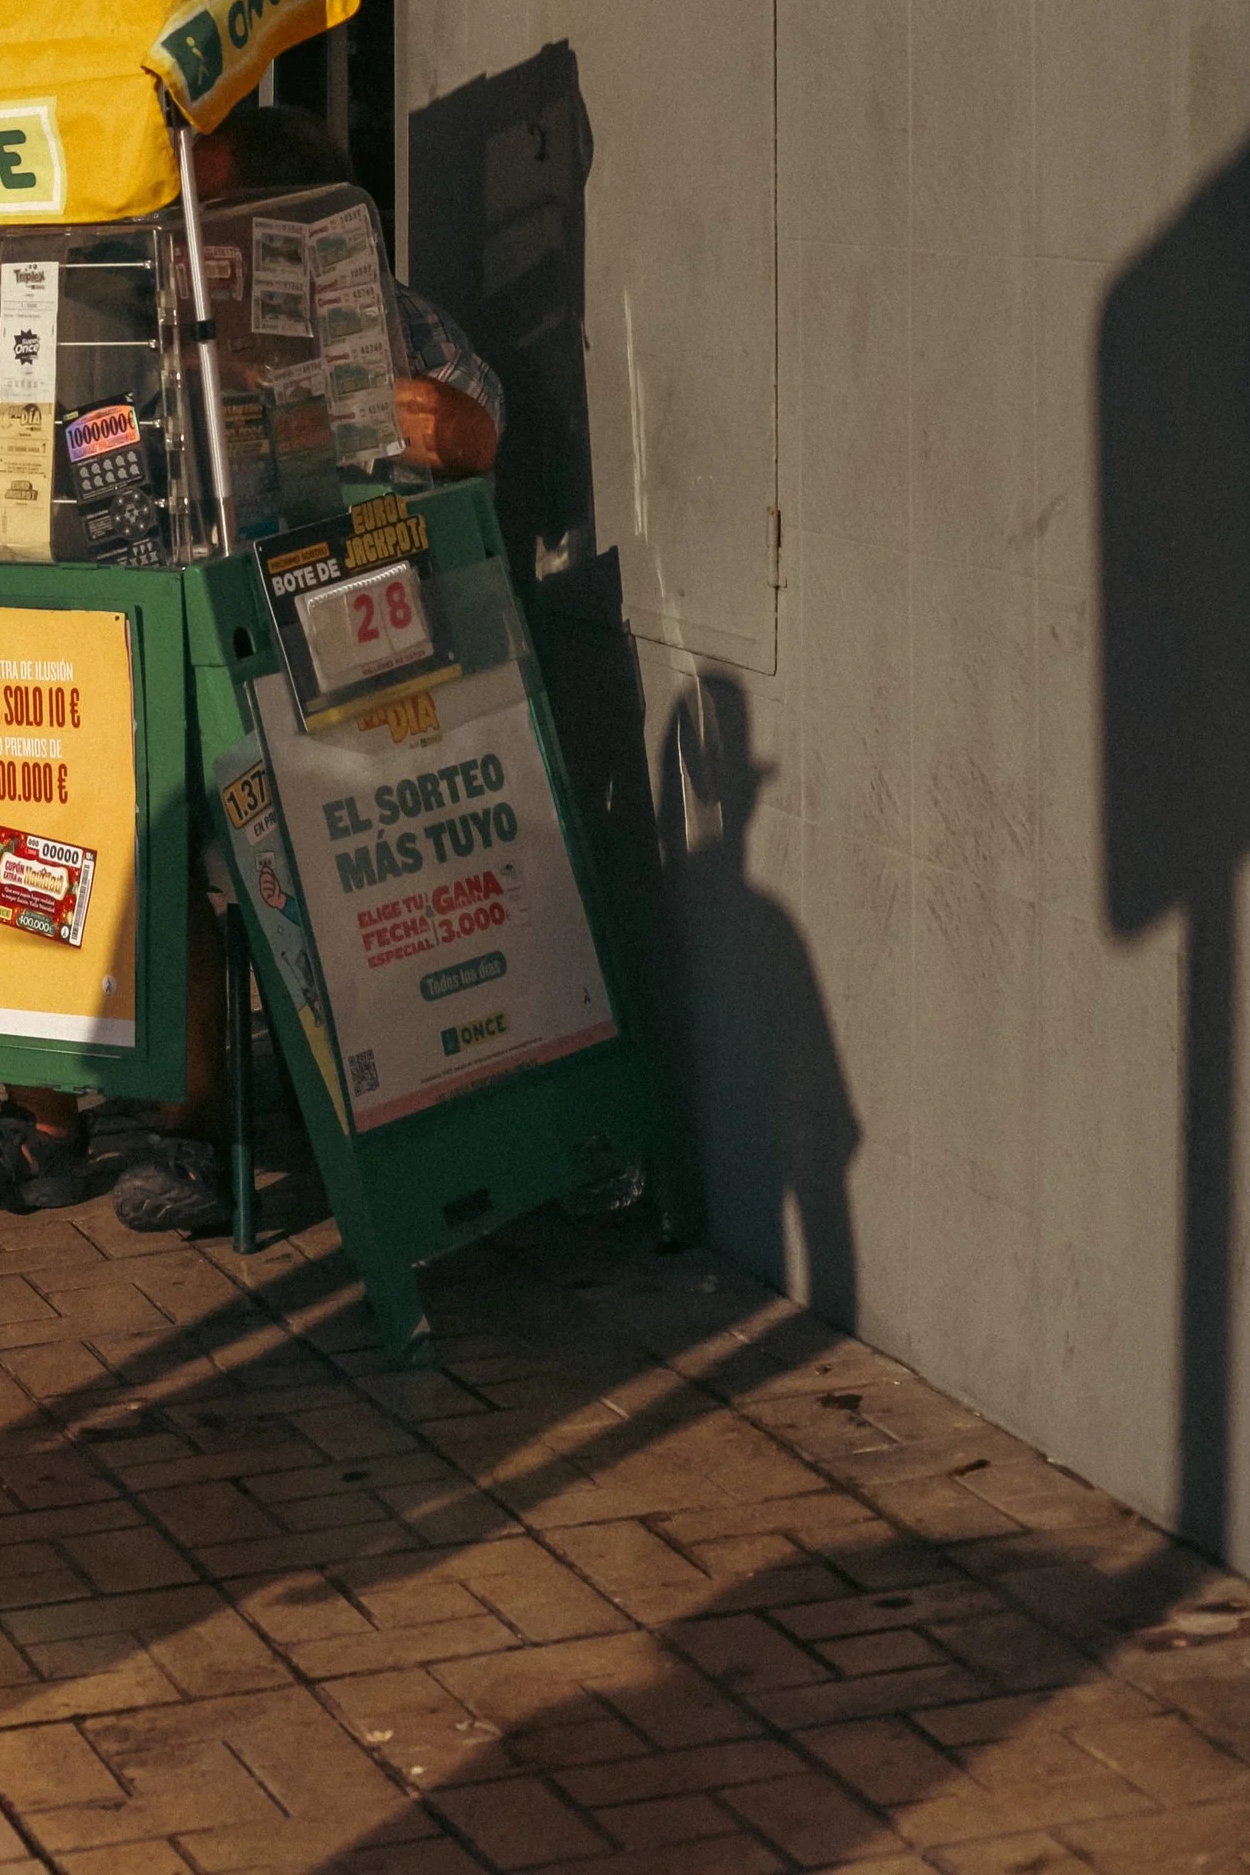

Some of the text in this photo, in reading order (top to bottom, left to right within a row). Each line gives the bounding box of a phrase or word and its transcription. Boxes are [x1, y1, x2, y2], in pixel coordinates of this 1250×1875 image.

[14, 343, 40, 354] Once
[352, 495, 398, 534] EURO
[345, 516, 425, 570] JACKPOT
[271, 558, 341, 597] BOTE DE
[20, 660, 33, 680] DE
[35, 658, 74, 682] ILUSIÓN
[3, 685, 44, 727] SOLO
[48, 687, 66, 728] 10
[69, 687, 81, 729] €
[4, 737, 47, 758] PREMIOS
[49, 738, 63, 759] DE
[57, 763, 69, 805] €
[322, 753, 505, 842] EL SORTEO
[253, 821, 265, 838] EN
[335, 801, 518, 894] MÁS TUYO
[5, 860, 25, 875] CUPÓN
[42, 843, 80, 865] 00000
[24, 865, 64, 893] Navidad
[432, 871, 504, 915] GANA
[357, 893, 424, 929] ELIGE TU
[362, 915, 431, 952] FECHA
[368, 938, 435, 969] ESPECIAL
[425, 959, 502, 996] Todos los días
[460, 1014, 508, 1045] ONCE
